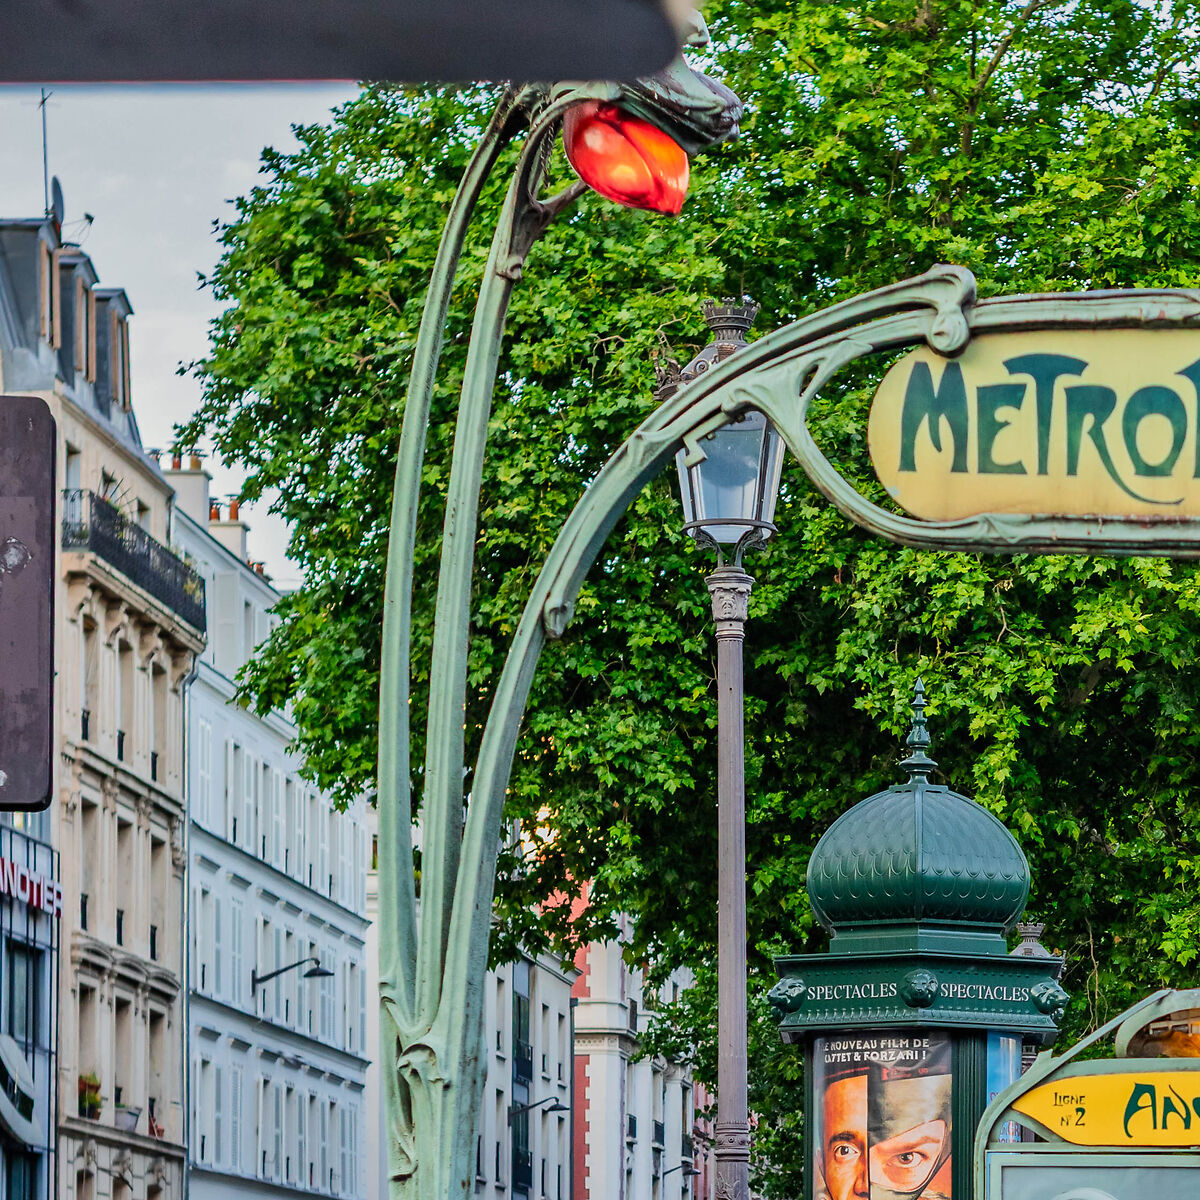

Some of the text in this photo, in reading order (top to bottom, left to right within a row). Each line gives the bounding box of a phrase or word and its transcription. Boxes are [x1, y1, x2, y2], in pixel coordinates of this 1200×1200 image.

[807, 982, 897, 1000] SPECTACLES
[940, 983, 1030, 1001] SPECTACLES
[831, 1040, 877, 1050] NOUVEAU
[880, 1038, 909, 1048] FILM
[913, 1038, 929, 1048] DE
[854, 1052, 861, 1062] &
[864, 1050, 918, 1061] FORZANI
[1053, 1092, 1085, 1106] LIGNE
